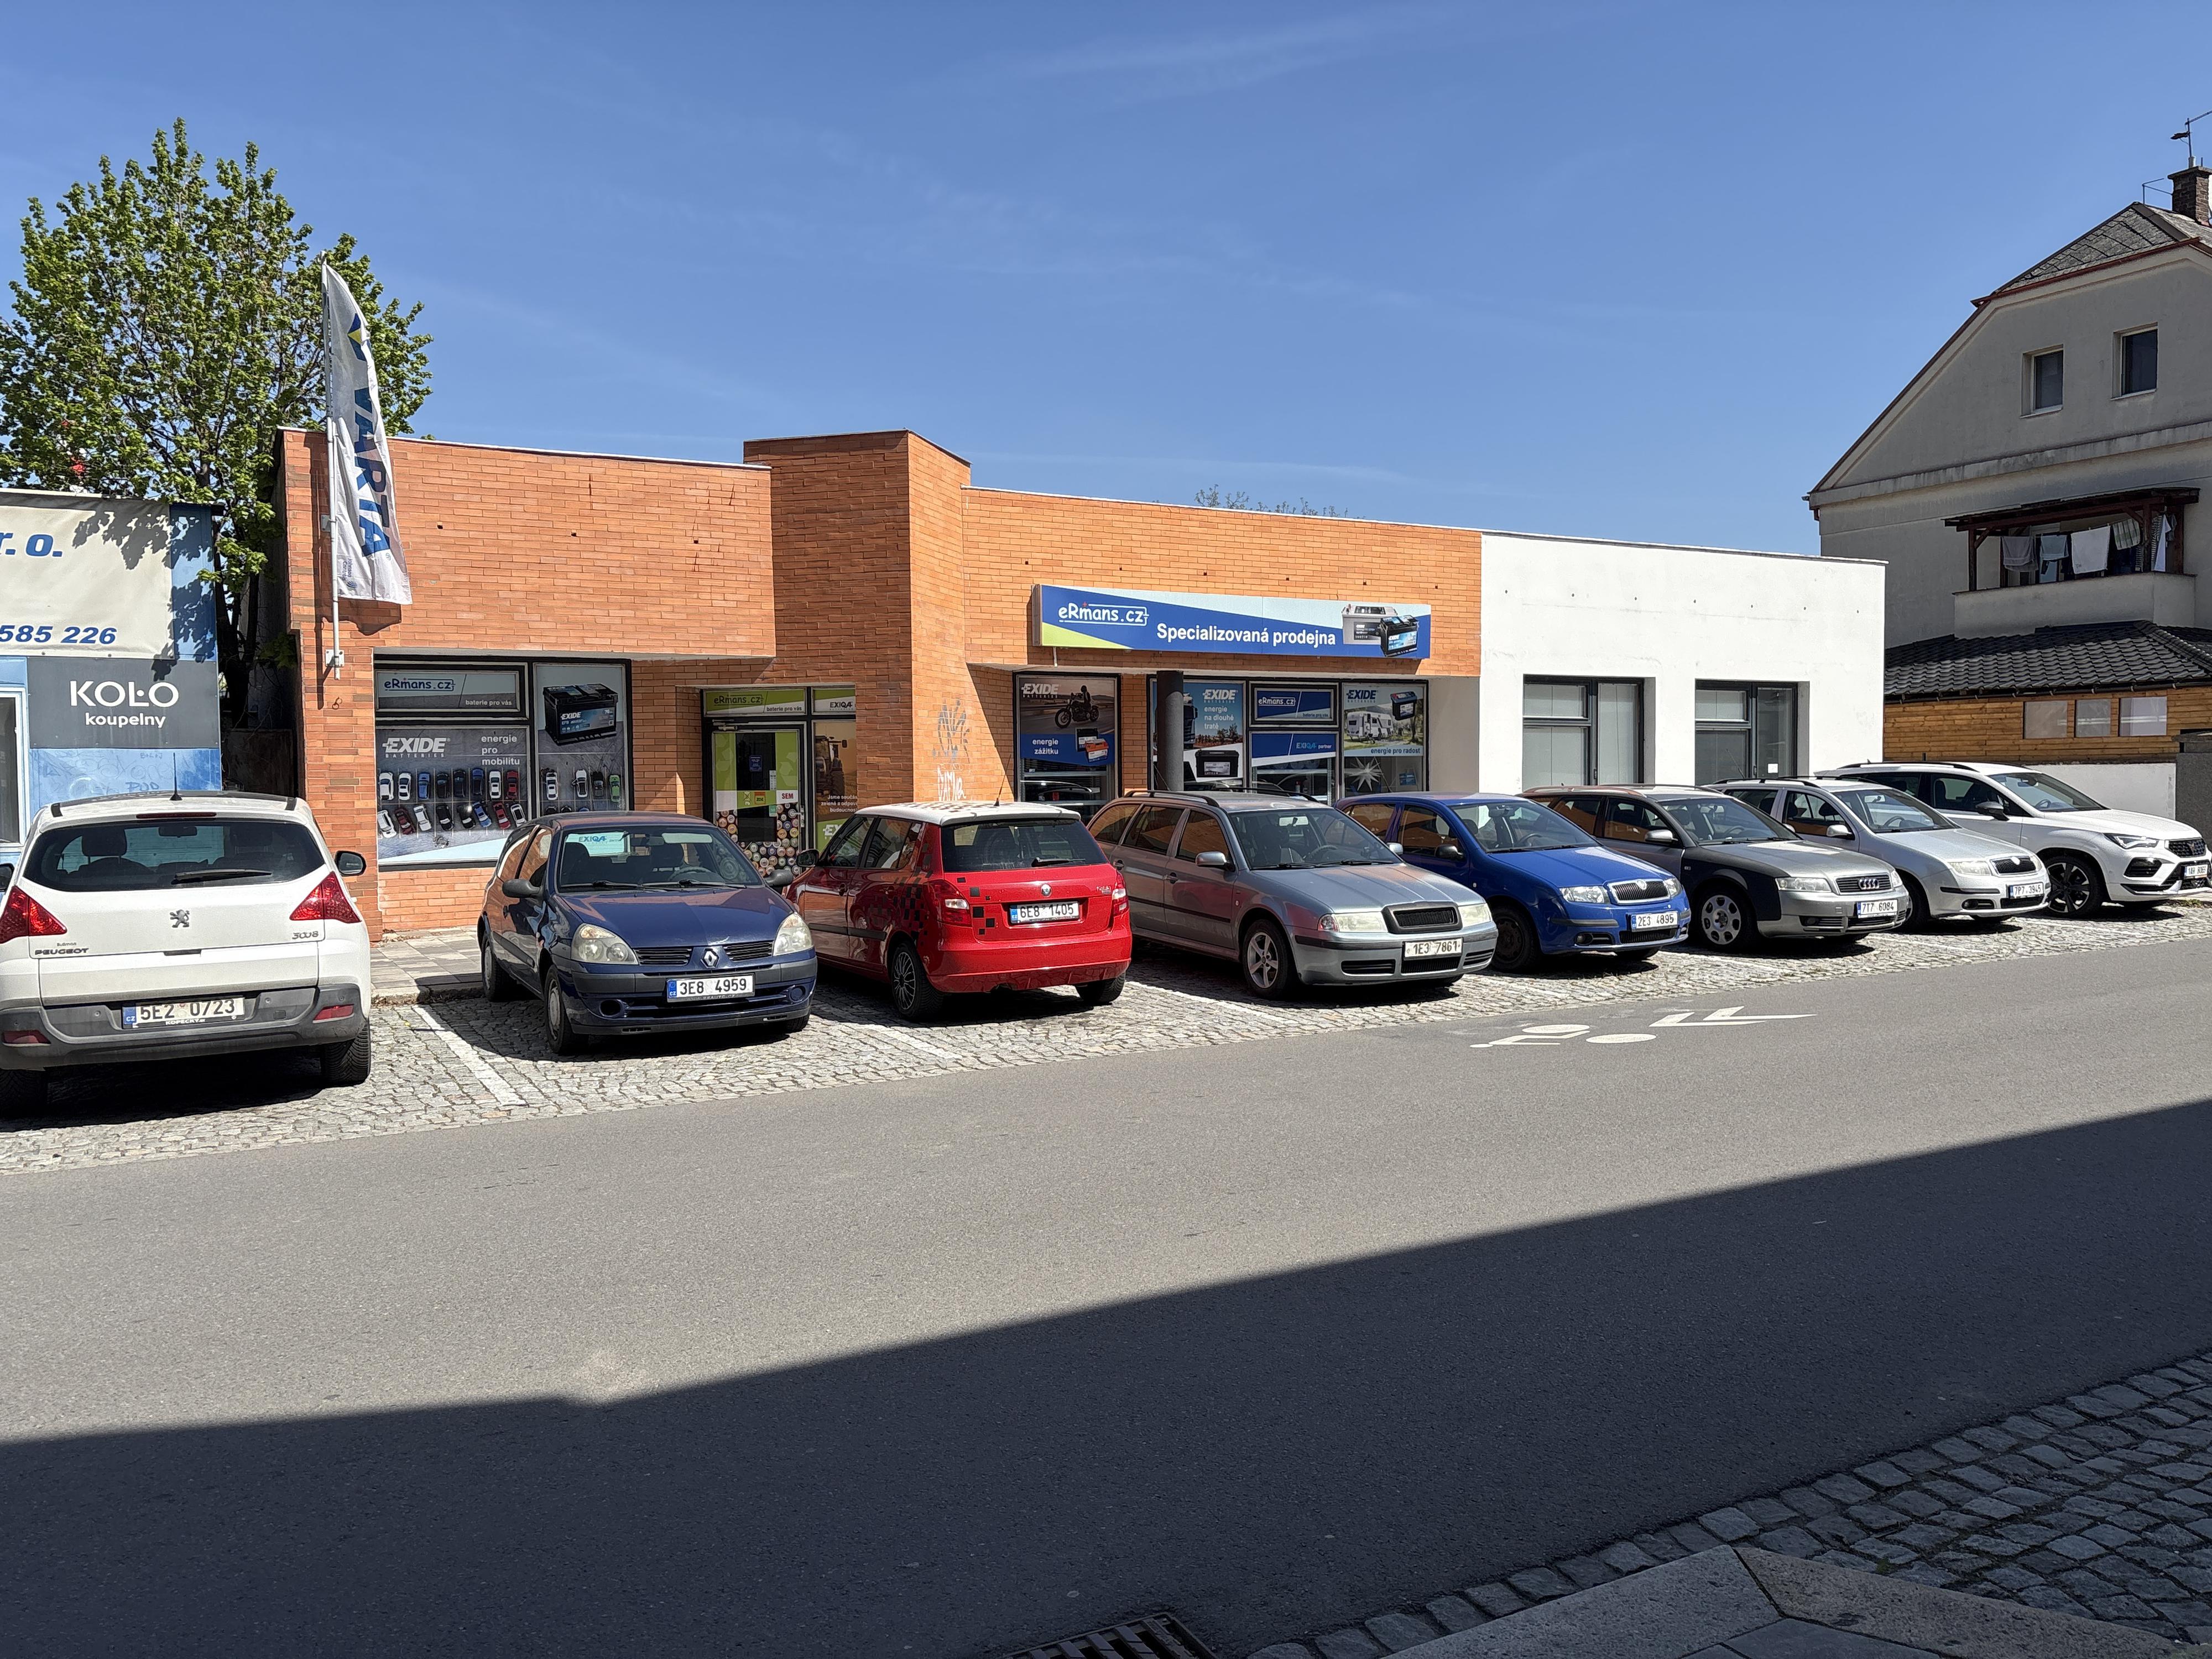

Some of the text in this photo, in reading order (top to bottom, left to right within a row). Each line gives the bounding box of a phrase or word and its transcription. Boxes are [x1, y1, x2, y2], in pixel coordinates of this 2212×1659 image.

[26, 534, 62, 557] o.
[1058, 603, 1144, 623] eRmans.cz
[0, 625, 117, 644] 585 226
[1157, 623, 1269, 644] Specializovaná
[1273, 629, 1336, 649] prodejna
[384, 678, 452, 690] eRmans.cz
[1021, 683, 1059, 695] EXIDE
[1202, 689, 1237, 700] EXIDE
[1346, 690, 1377, 700] EXIDE
[85, 712, 166, 728] koupelny
[561, 712, 581, 720] EXIDE
[382, 737, 447, 753] EXIDE
[481, 734, 517, 744] energie
[1032, 738, 1059, 747] energie
[482, 747, 498, 755] pro
[482, 757, 520, 765] mobilitu
[1020, 903, 1074, 918] 6E8 1405
[1862, 901, 1894, 913] 7T7 6084
[1638, 914, 1674, 926] 2E3 4895
[291, 930, 319, 940] 3008
[34, 947, 89, 956] PEUGEOT
[1413, 941, 1457, 954] 1E3 7861
[680, 978, 747, 995] 3E8 4959
[140, 999, 235, 1020] 5E2 0723
